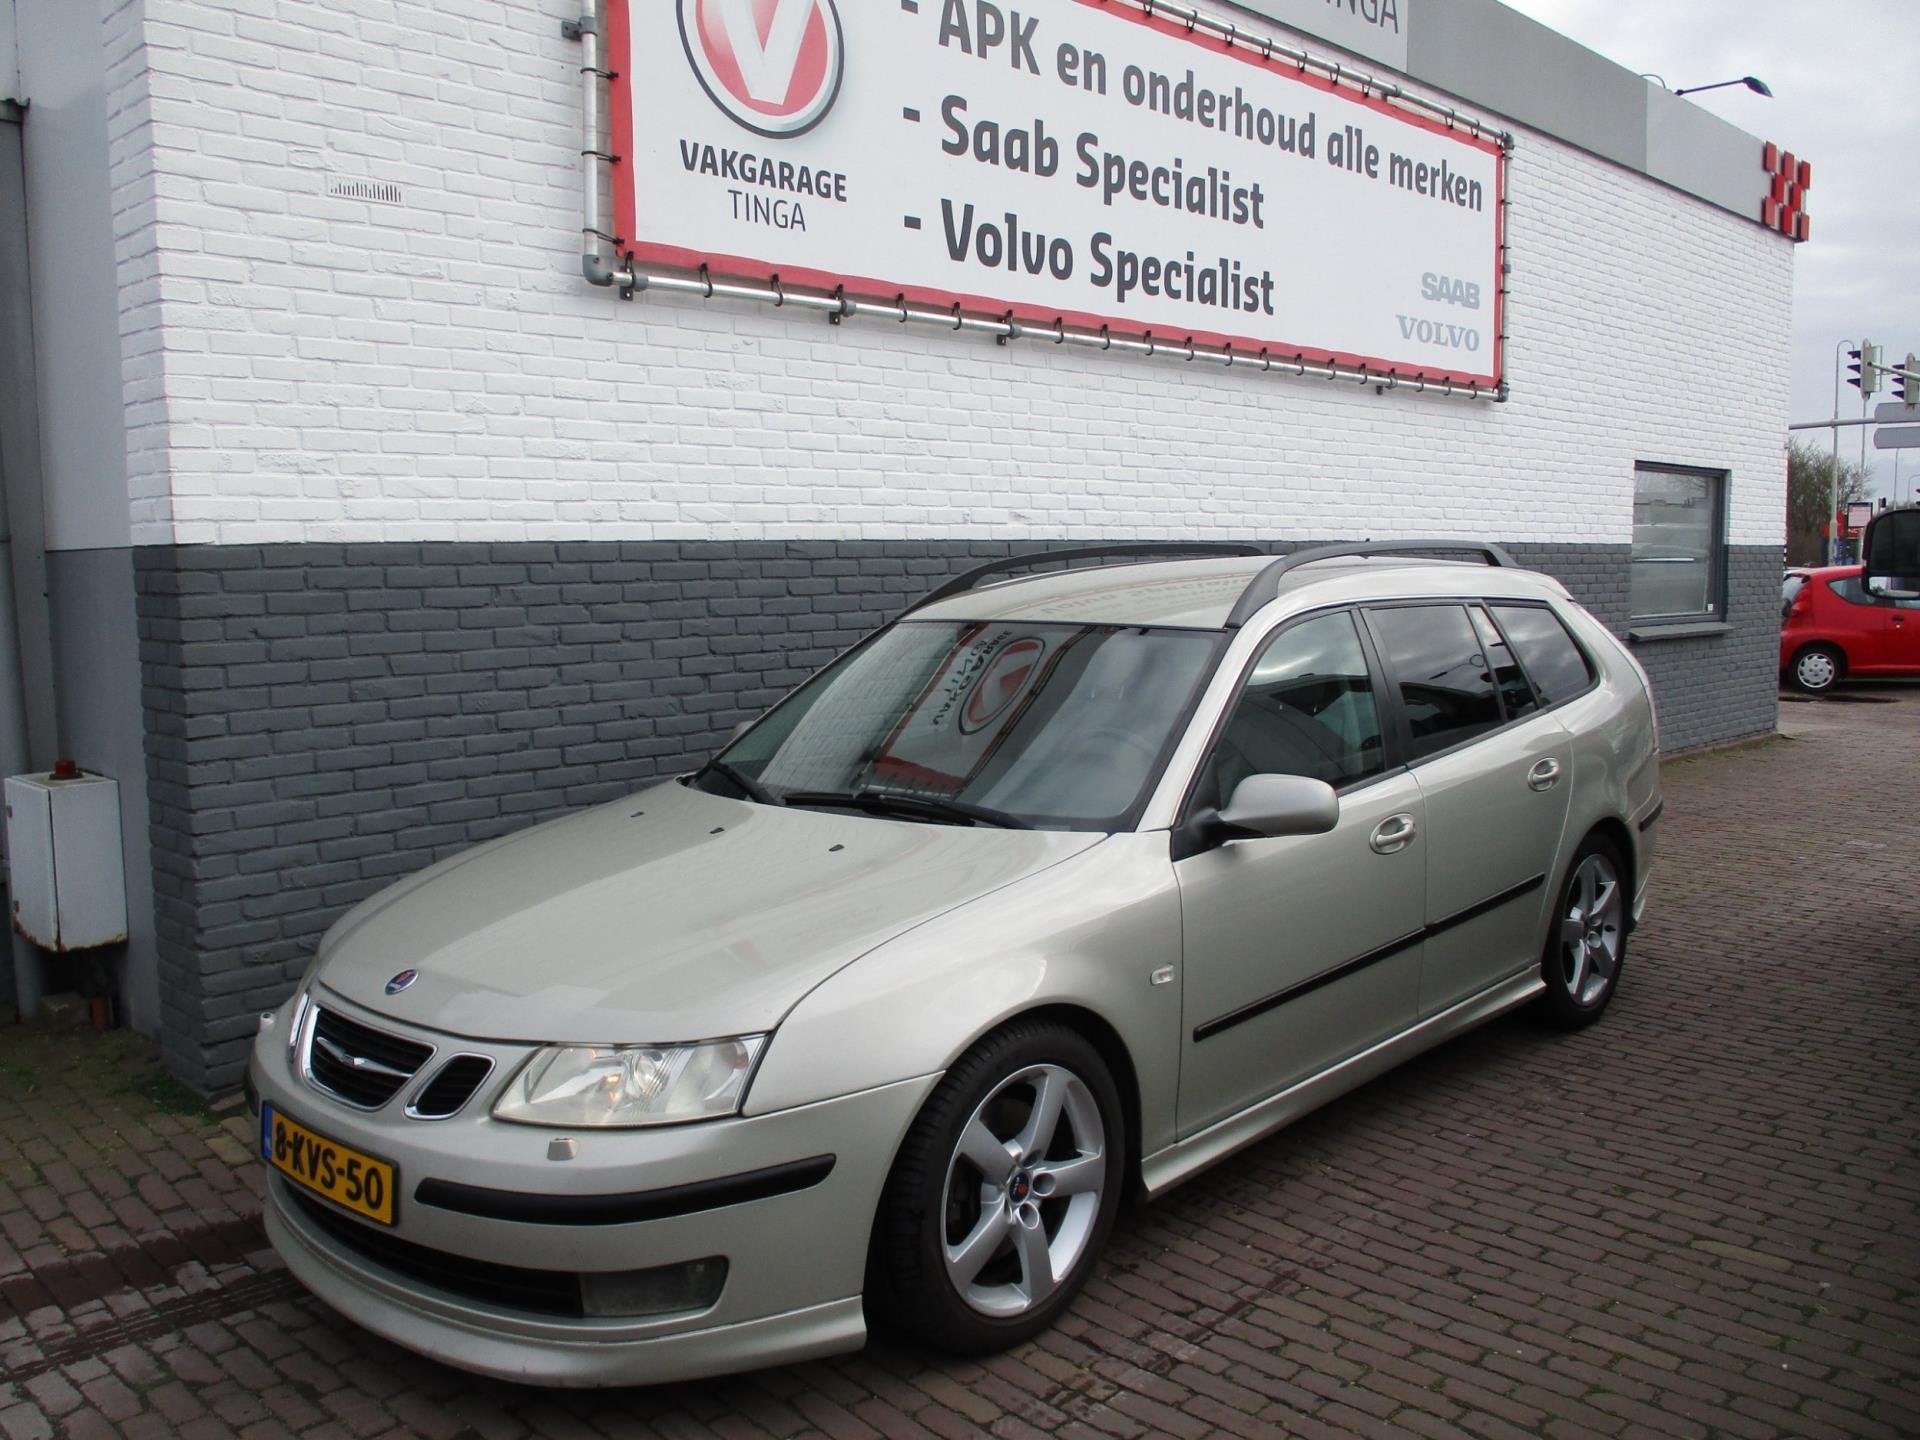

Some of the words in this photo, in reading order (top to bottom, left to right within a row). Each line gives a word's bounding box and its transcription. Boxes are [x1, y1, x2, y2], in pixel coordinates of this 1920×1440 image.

[938, 0, 1041, 76] APK
[1056, 42, 1107, 95] en
[1123, 64, 1316, 160] onderhoud
[1327, 125, 1379, 179] alle
[1389, 152, 1482, 212] merken
[680, 140, 848, 203] VAKGARAGE
[941, 95, 1059, 178] Saab
[1076, 132, 1264, 229] Specialist
[727, 189, 807, 232] TINGA
[940, 198, 1074, 281] Volvo
[1090, 231, 1274, 316] Specialist
[1421, 272, 1480, 310] SAAB
[1395, 314, 1480, 352] VOLVO
[275, 1121, 383, 1210] 8-KVS-50
